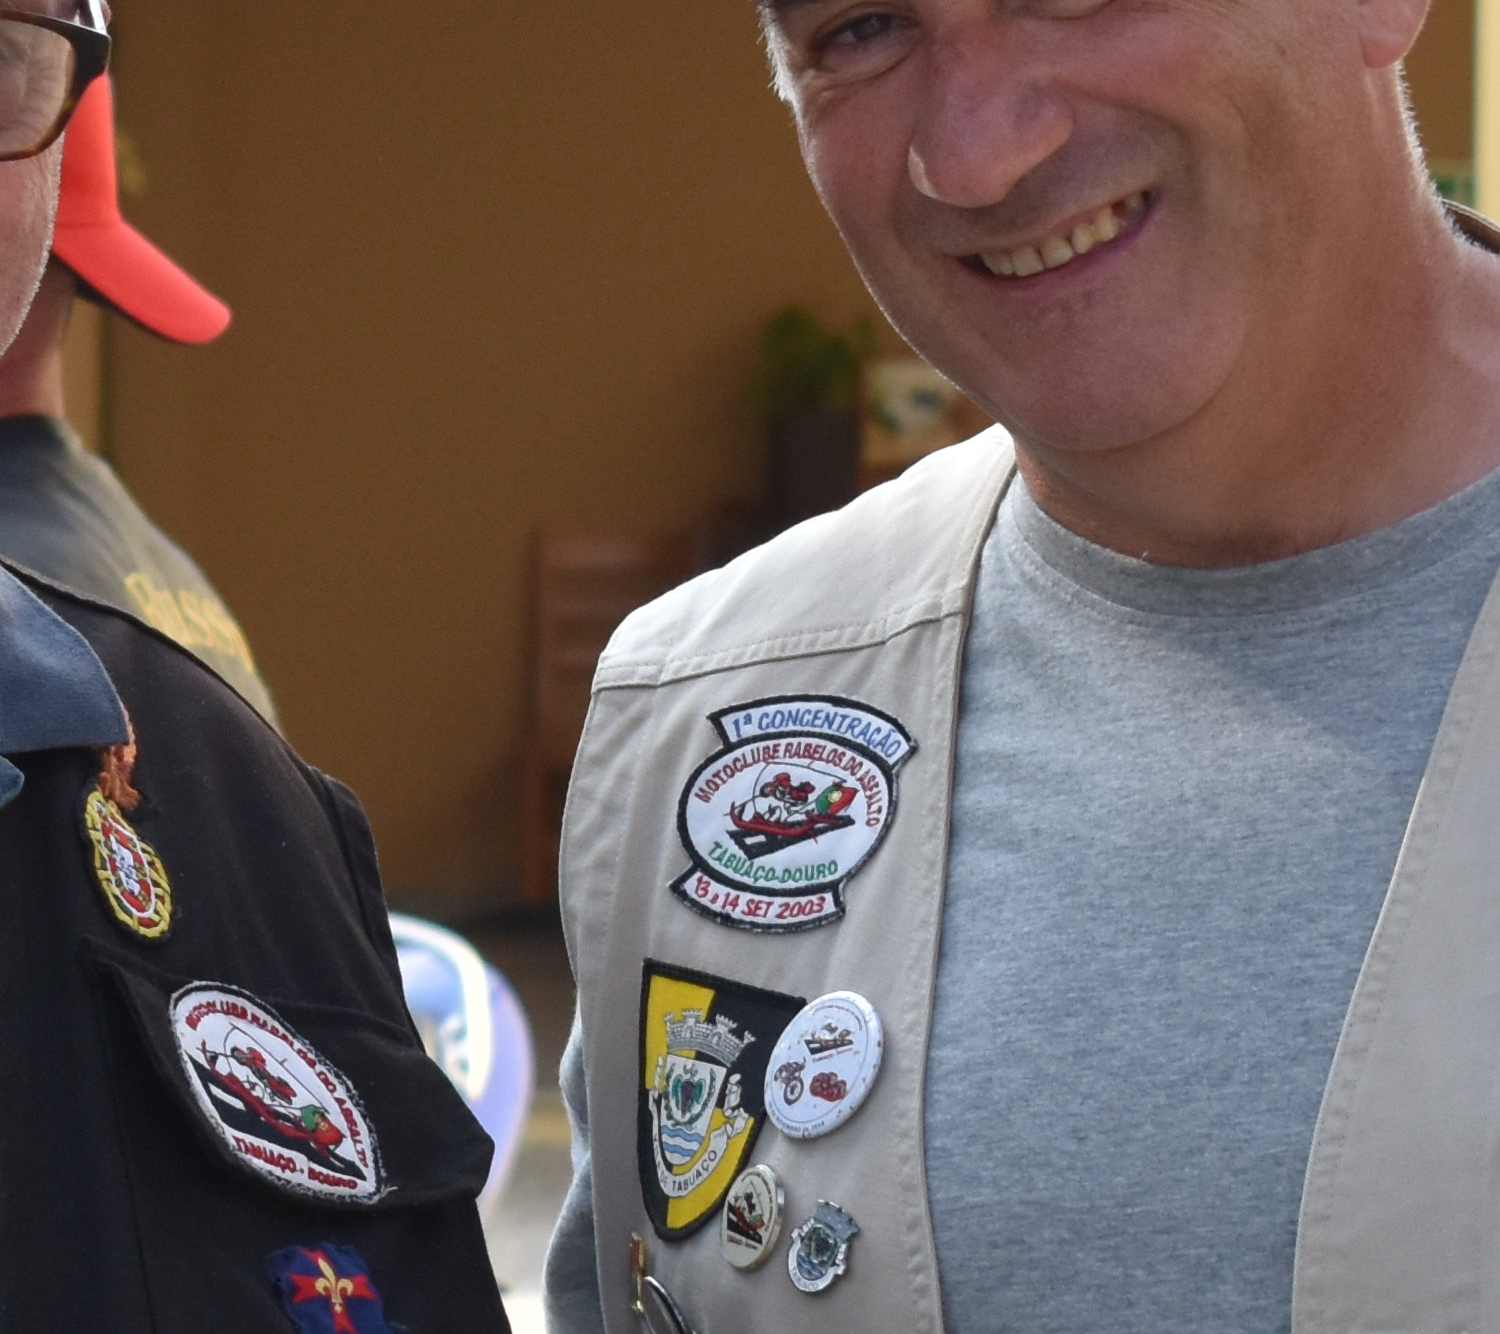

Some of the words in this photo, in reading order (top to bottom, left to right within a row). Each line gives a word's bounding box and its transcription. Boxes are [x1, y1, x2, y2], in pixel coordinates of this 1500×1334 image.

[757, 708, 901, 759] CONCENTRAÇÃO
[694, 742, 781, 804] MOTOCLUBE
[782, 741, 845, 767] RABELOS
[842, 756, 864, 777] DO
[856, 769, 884, 828] ASFALTO
[694, 875, 711, 898] 13
[722, 892, 740, 911] 14
[741, 899, 771, 919] SET
[775, 896, 826, 919] 2003
[671, 1149, 718, 1192] TABUAÇO
